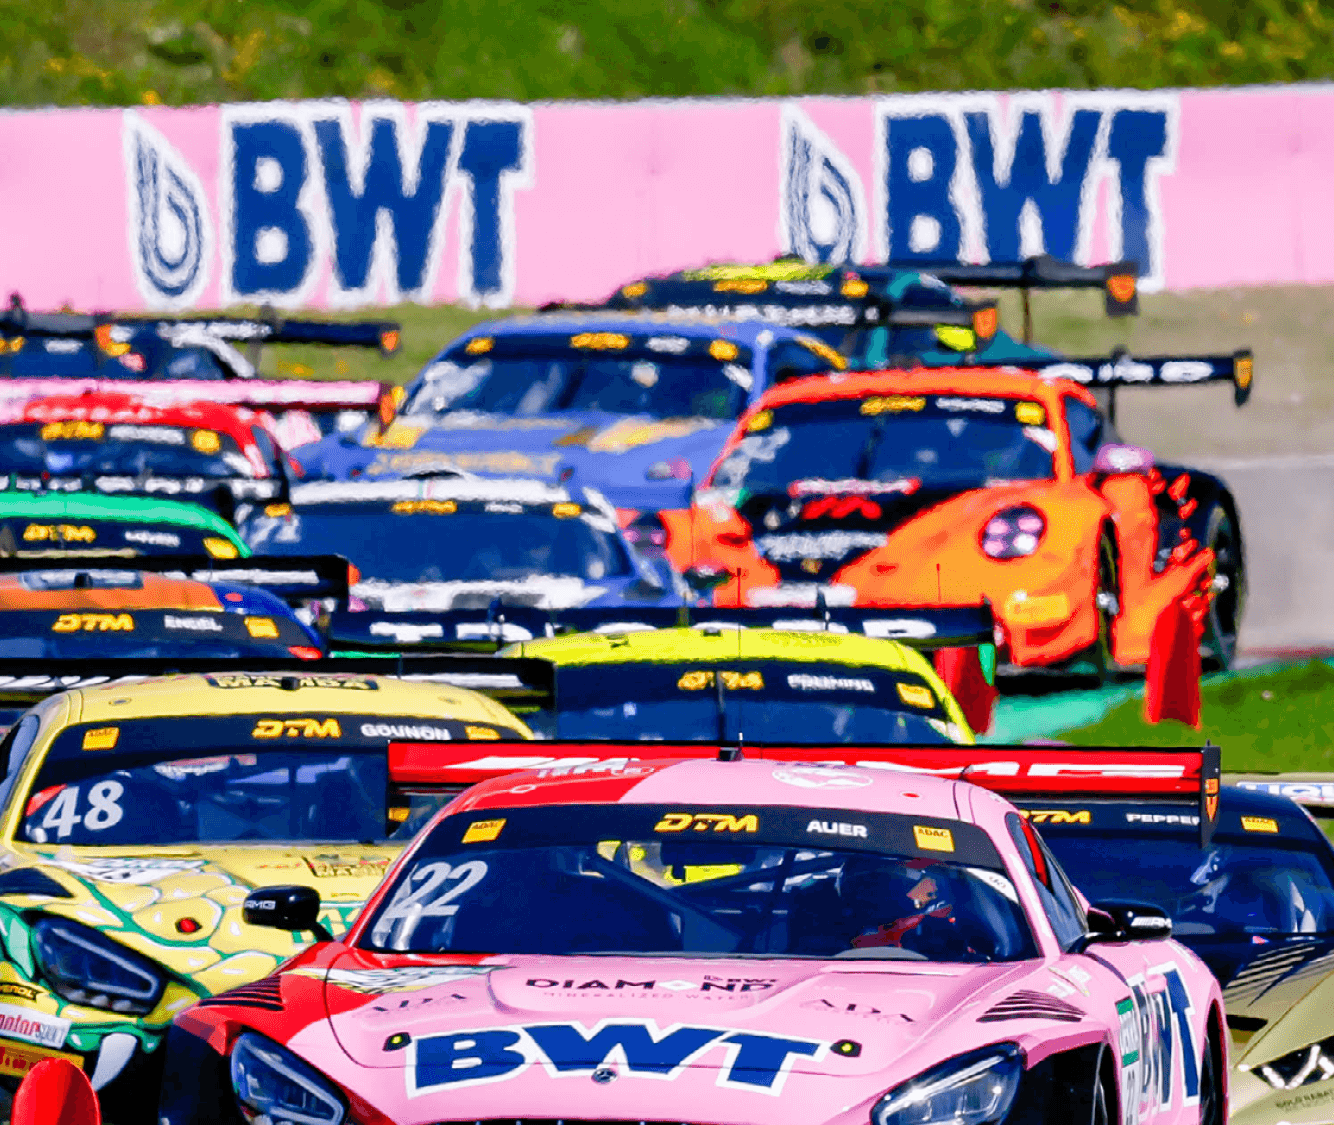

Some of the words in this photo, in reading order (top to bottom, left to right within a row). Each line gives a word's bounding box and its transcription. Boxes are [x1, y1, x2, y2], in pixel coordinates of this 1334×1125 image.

[230, 117, 526, 296] BWT
[884, 108, 1168, 278] BWT
[52, 614, 135, 632] DTM
[252, 719, 342, 739] DTM
[361, 723, 451, 741] GOUNON
[43, 780, 124, 836] 48
[654, 814, 759, 834] DTM
[807, 819, 867, 837] AUER
[386, 860, 488, 918] 22
[413, 1021, 825, 1092] BWT
